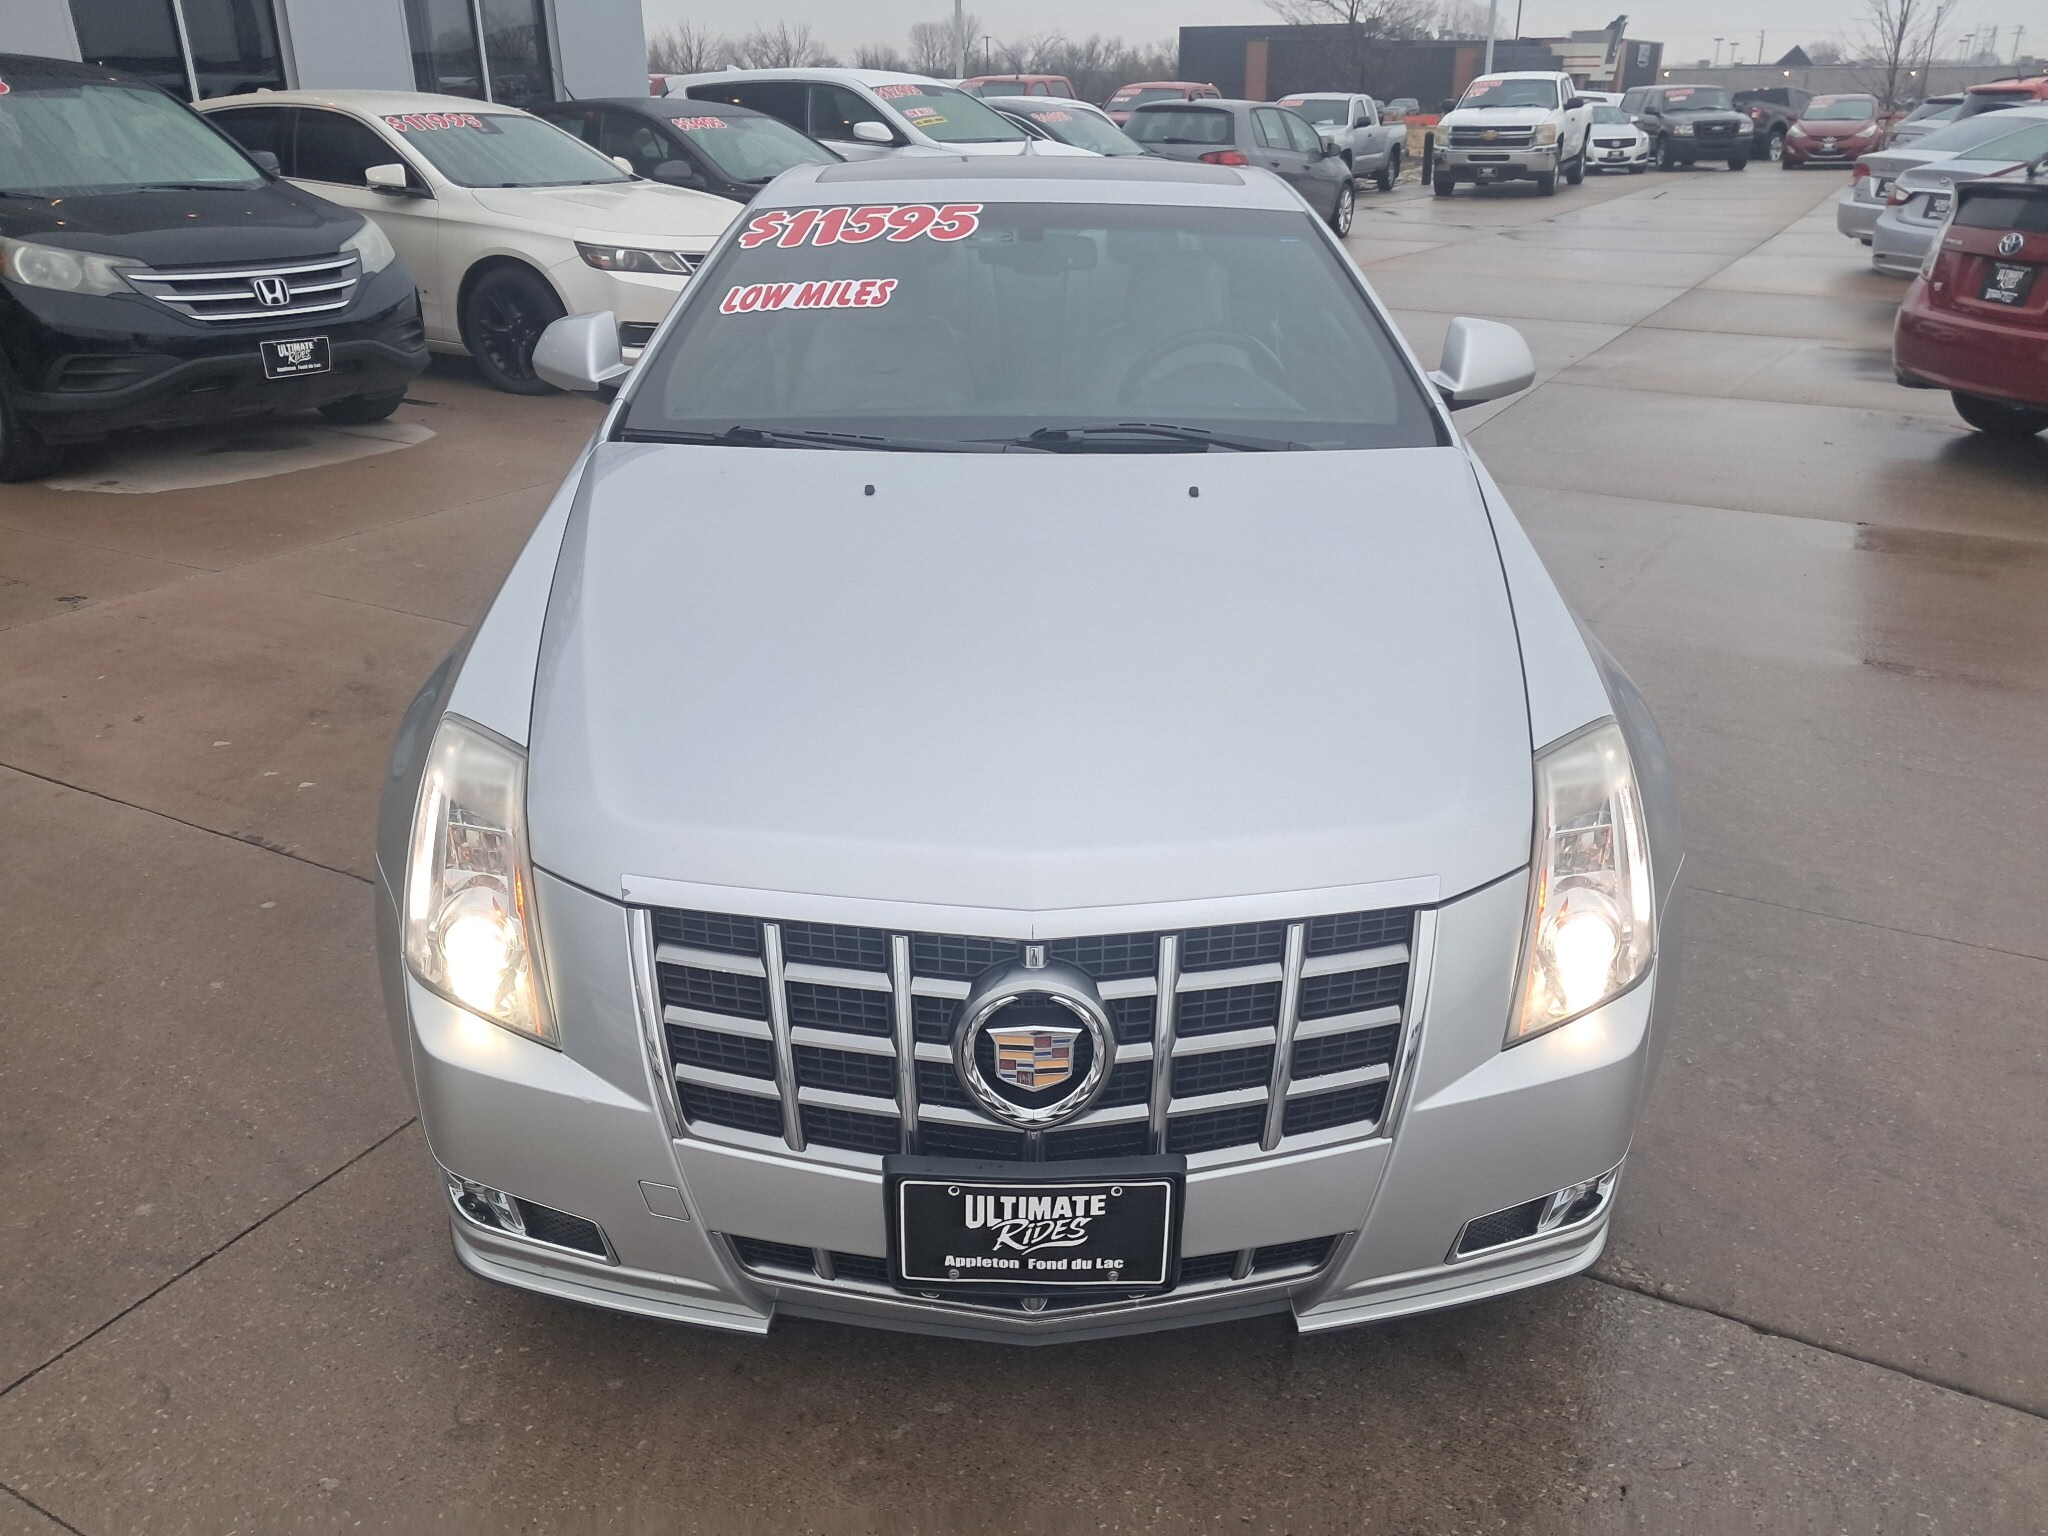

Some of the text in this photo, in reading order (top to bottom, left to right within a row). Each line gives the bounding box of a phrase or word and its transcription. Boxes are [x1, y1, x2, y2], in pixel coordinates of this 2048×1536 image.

[385, 113, 482, 132] $11995
[738, 204, 983, 248] $11595
[721, 279, 898, 314] LOW MILES
[277, 341, 314, 357] ULTIMATE
[965, 1194, 1107, 1229] ULTIMATE
[944, 1254, 1124, 1270] Appleton Fond du Lac
